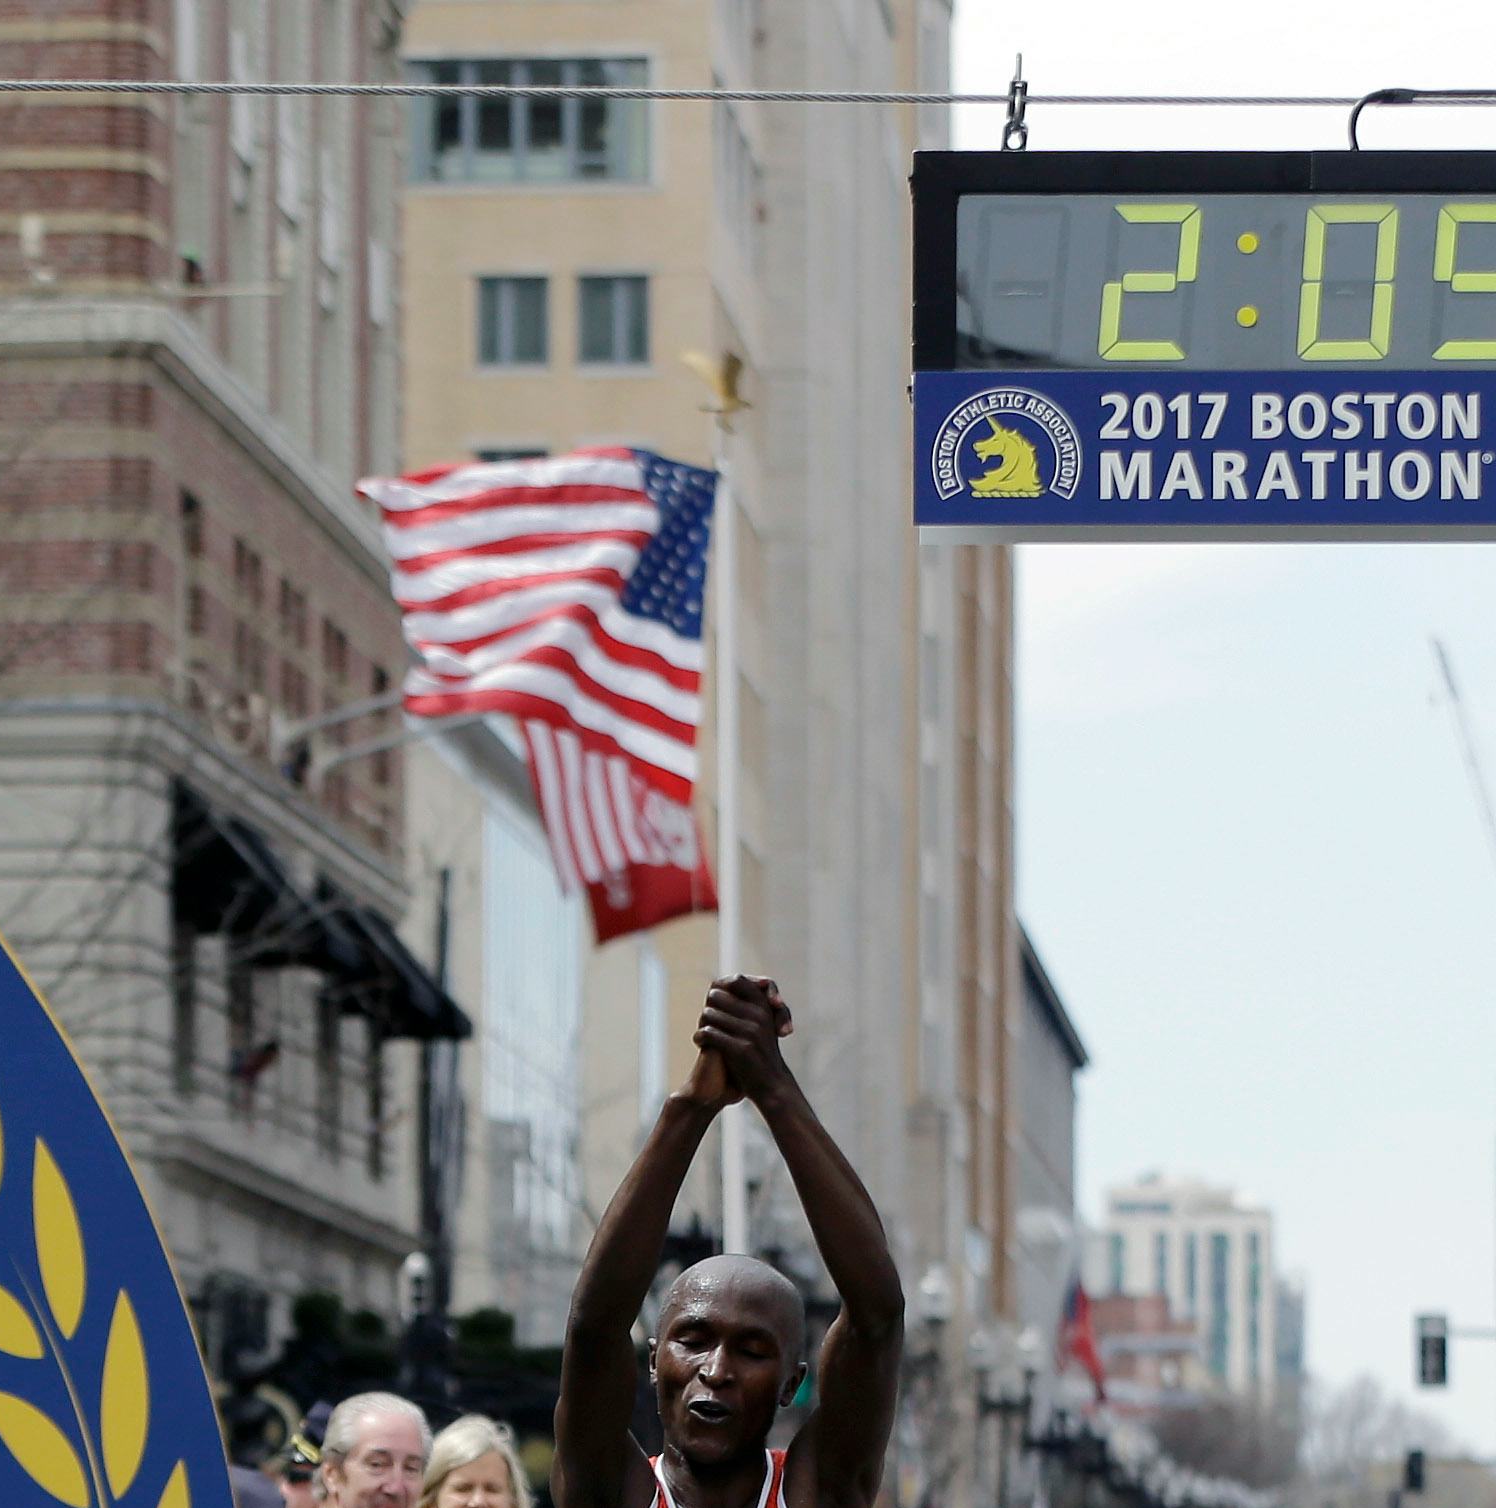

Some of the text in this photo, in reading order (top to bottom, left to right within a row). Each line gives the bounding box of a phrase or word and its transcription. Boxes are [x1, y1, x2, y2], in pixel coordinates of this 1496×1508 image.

[937, 393, 1076, 490] BOSTON ATHLETIC ASSOCIATION
[1099, 393, 1480, 441] 2017 BOSTON
[1100, 451, 1482, 502] MARATHON
